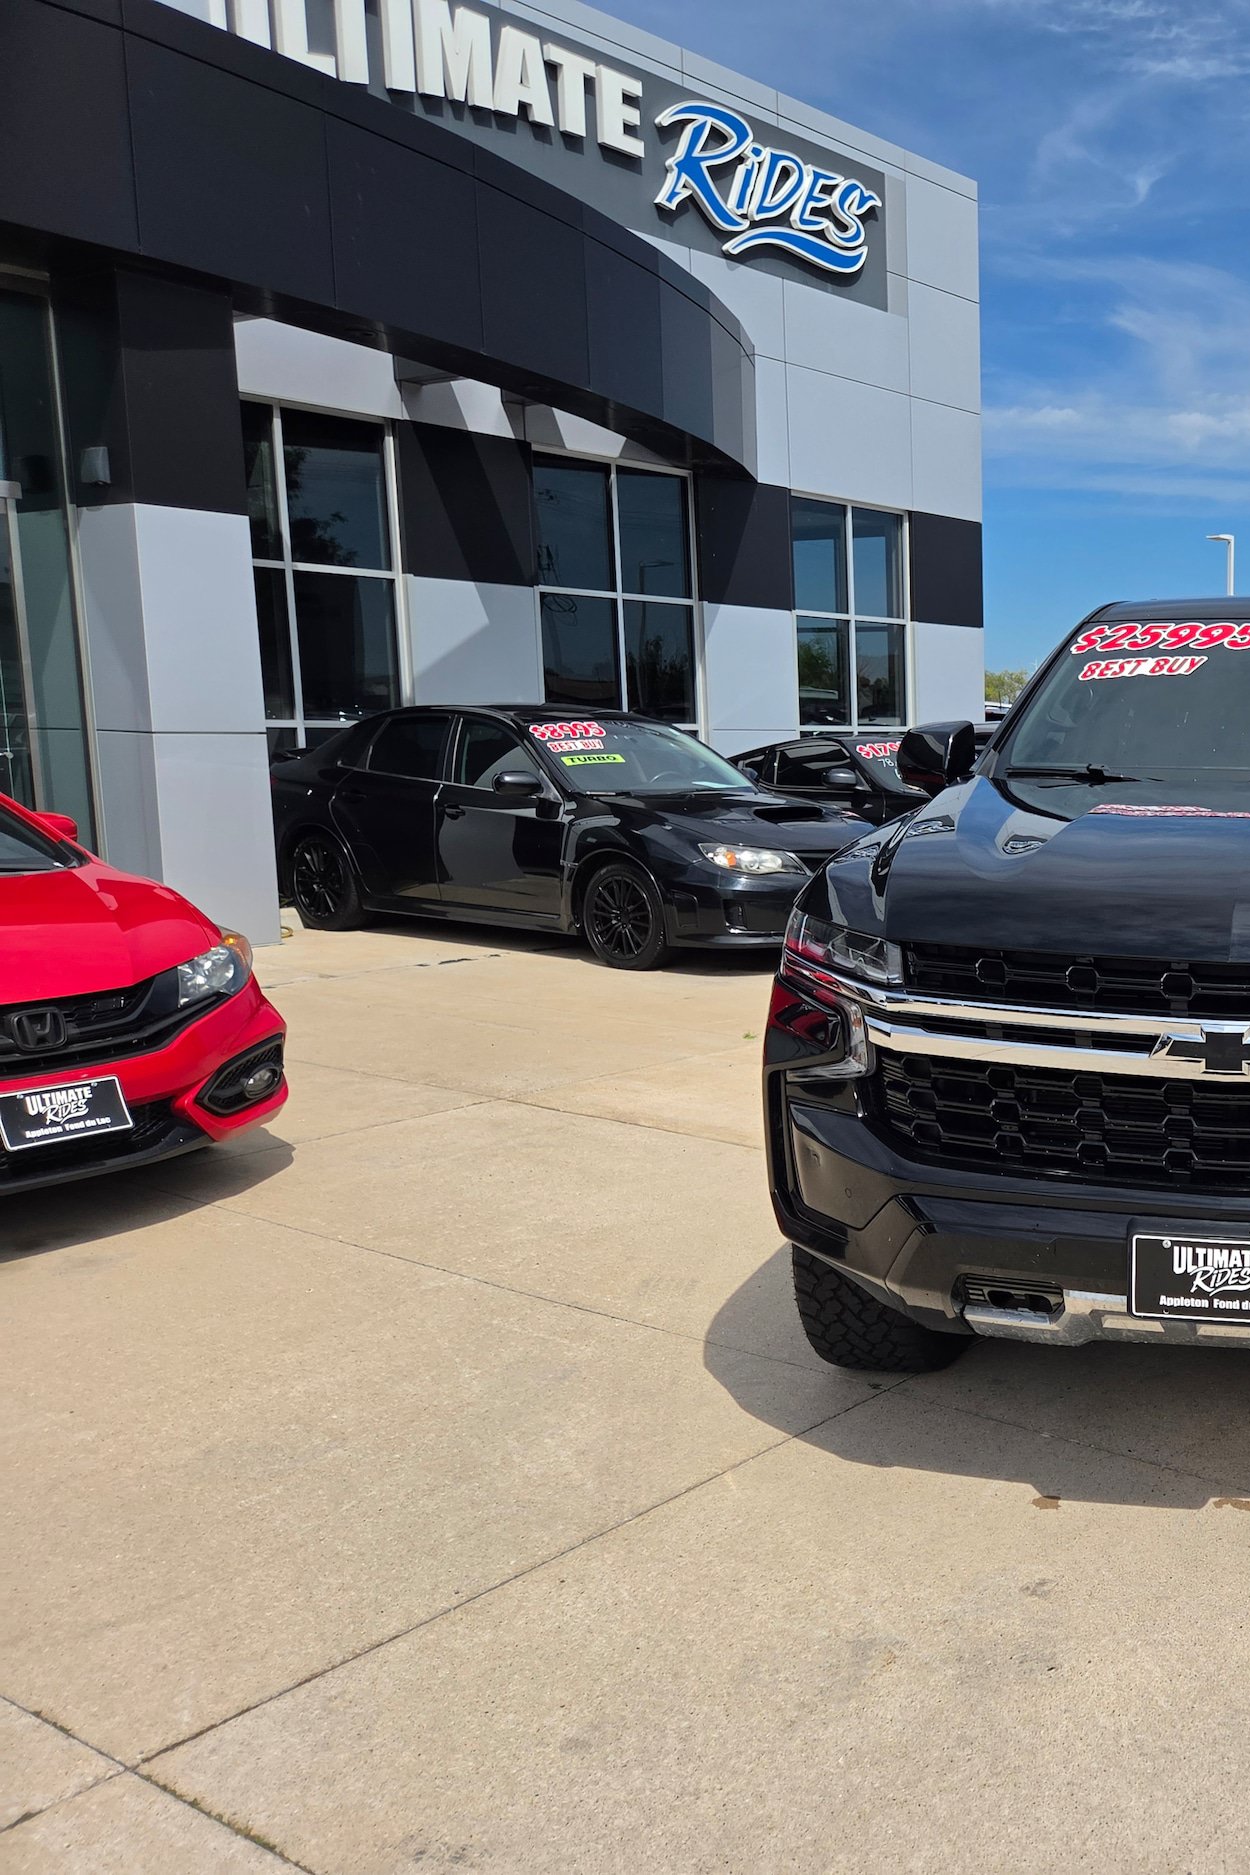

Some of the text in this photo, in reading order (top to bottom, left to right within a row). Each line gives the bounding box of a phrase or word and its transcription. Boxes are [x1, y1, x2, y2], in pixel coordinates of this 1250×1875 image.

[1079, 656, 1208, 680] BEST BUY
[529, 721, 606, 740] $8995
[547, 739, 604, 753] BEST BUY
[567, 755, 617, 763] TURBO
[25, 1086, 93, 1116] ULTIMATE
[25, 1117, 111, 1138] Appleton Fond du Lac
[1159, 1295, 1209, 1309] Appleton
[1213, 1298, 1240, 1310] Fond
